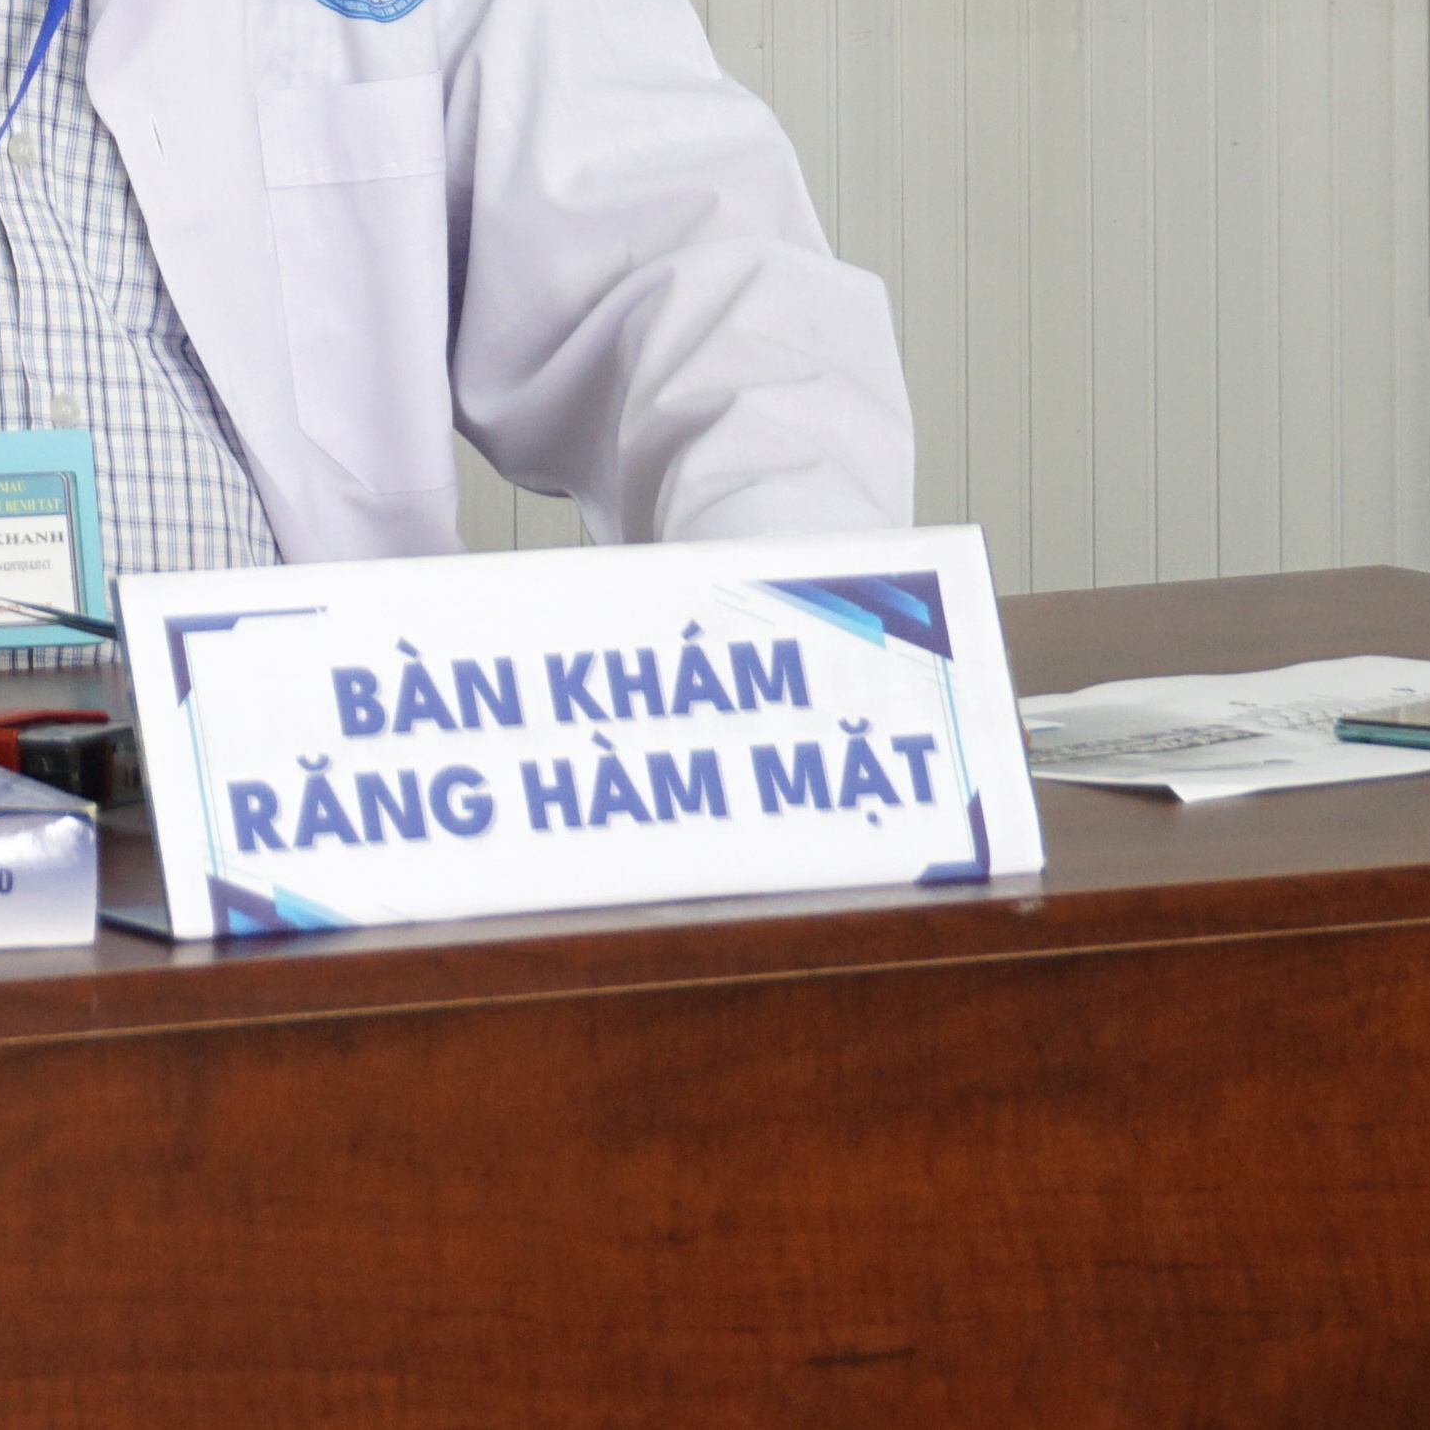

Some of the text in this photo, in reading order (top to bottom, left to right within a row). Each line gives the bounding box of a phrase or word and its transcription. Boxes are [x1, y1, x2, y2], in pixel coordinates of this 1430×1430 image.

[330, 621, 813, 738] BÀN KHÁM
[226, 754, 495, 854] RĂNG
[517, 731, 730, 831] HÀM
[751, 716, 938, 826] MẶT
